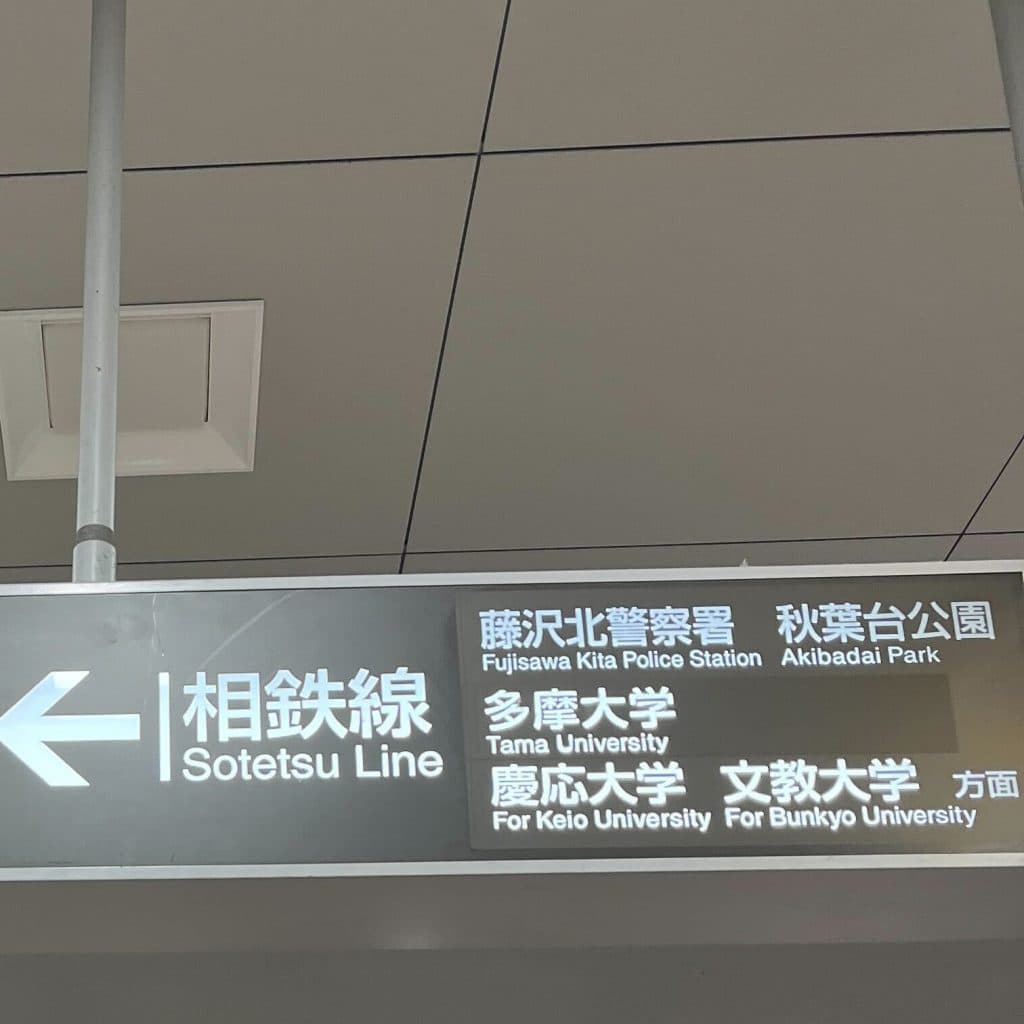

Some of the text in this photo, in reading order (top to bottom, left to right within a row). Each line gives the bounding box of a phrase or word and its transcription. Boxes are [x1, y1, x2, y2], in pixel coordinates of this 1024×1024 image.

[479, 606, 734, 649] 藤沢北警察署
[776, 601, 996, 643] 秋葉台公園
[482, 648, 762, 675] Fujisawa Kita Police Station
[781, 646, 941, 667] Akibadai Park
[183, 667, 432, 742] 相鉄線
[484, 687, 676, 731] 多摩大学
[182, 744, 443, 781] Sotetsu Line
[486, 733, 669, 755] Tama University
[491, 762, 686, 807] 慶応大学
[720, 758, 1019, 804] 文教大学 方面
[493, 808, 711, 832] For Keio University
[725, 806, 976, 830] For Bunkyo University
